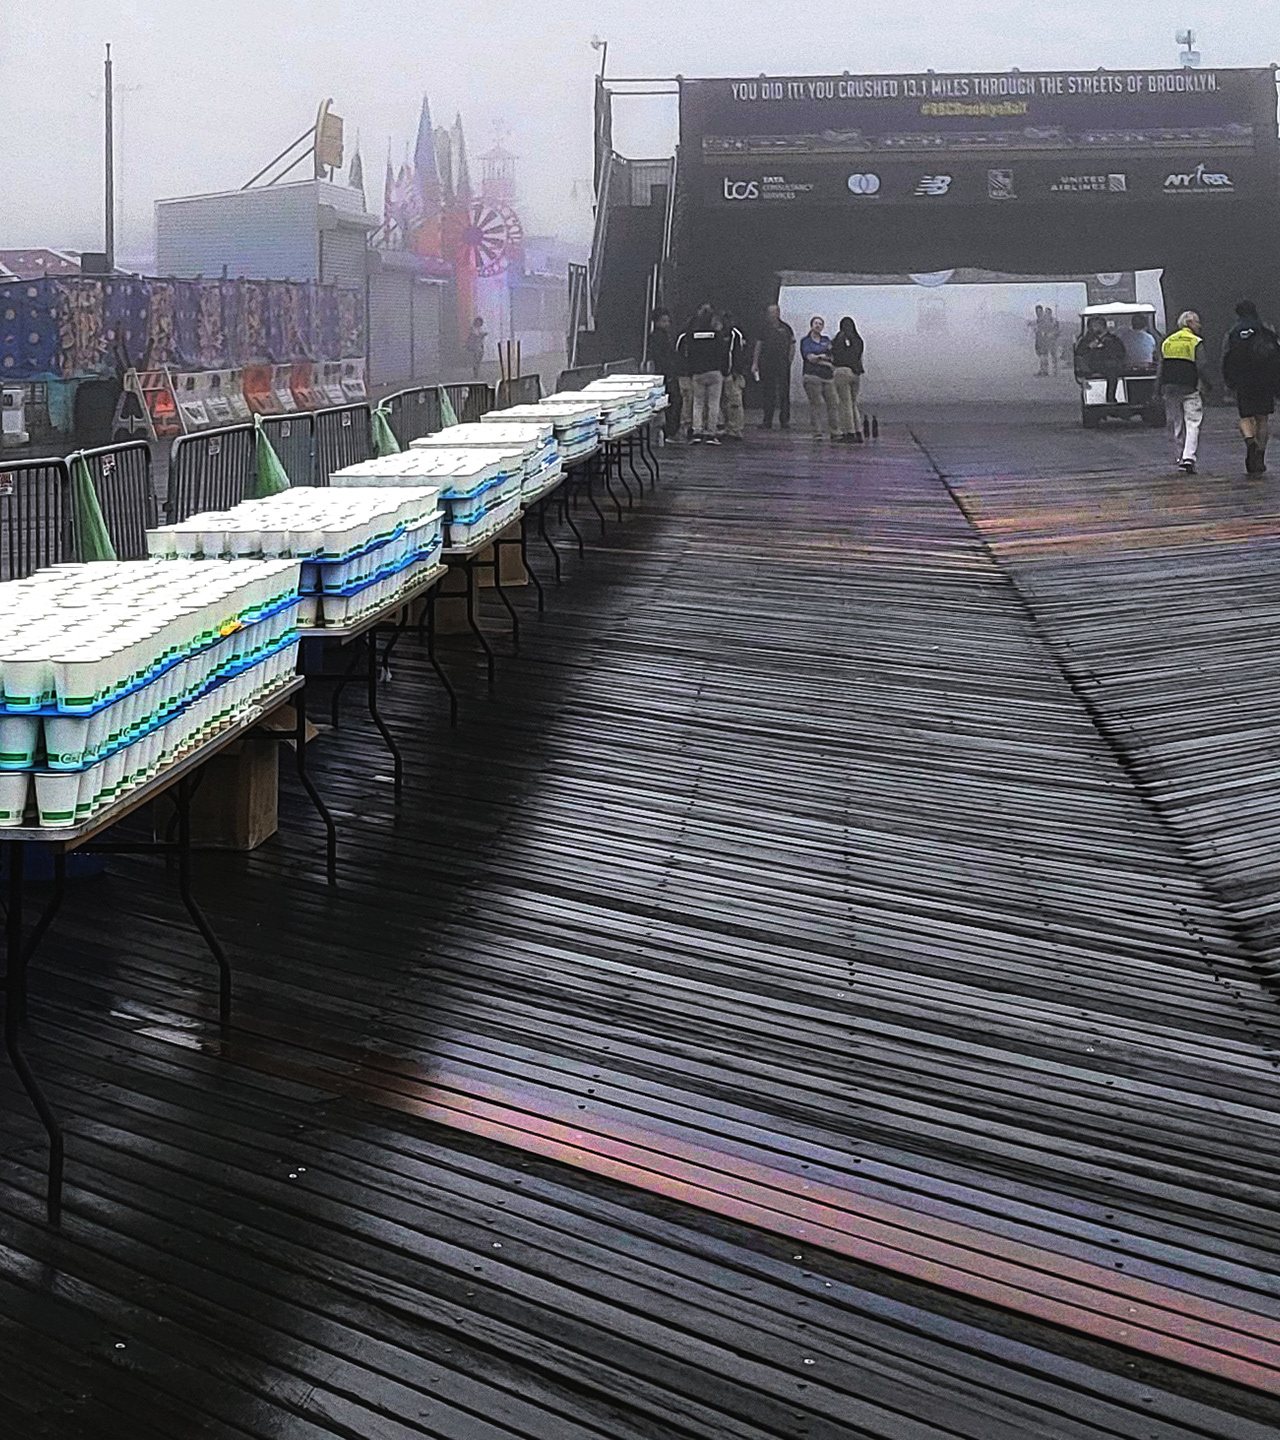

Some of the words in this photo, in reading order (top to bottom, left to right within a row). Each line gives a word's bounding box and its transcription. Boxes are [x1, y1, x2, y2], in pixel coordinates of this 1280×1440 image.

[732, 82, 758, 101] YOU
[761, 82, 783, 100] DID
[788, 82, 805, 99] IT!
[808, 81, 834, 99] YOU
[839, 79, 898, 99] CRUSHED
[903, 79, 927, 97] 13.1
[931, 78, 969, 96] MILES
[974, 77, 1035, 95] THROUGH
[1040, 76, 1064, 94] THE
[1068, 75, 1123, 93] STREETS
[1127, 75, 1143, 92] OF
[1060, 175, 1106, 184] UNITED
[1050, 183, 1106, 192] AIRLINES
